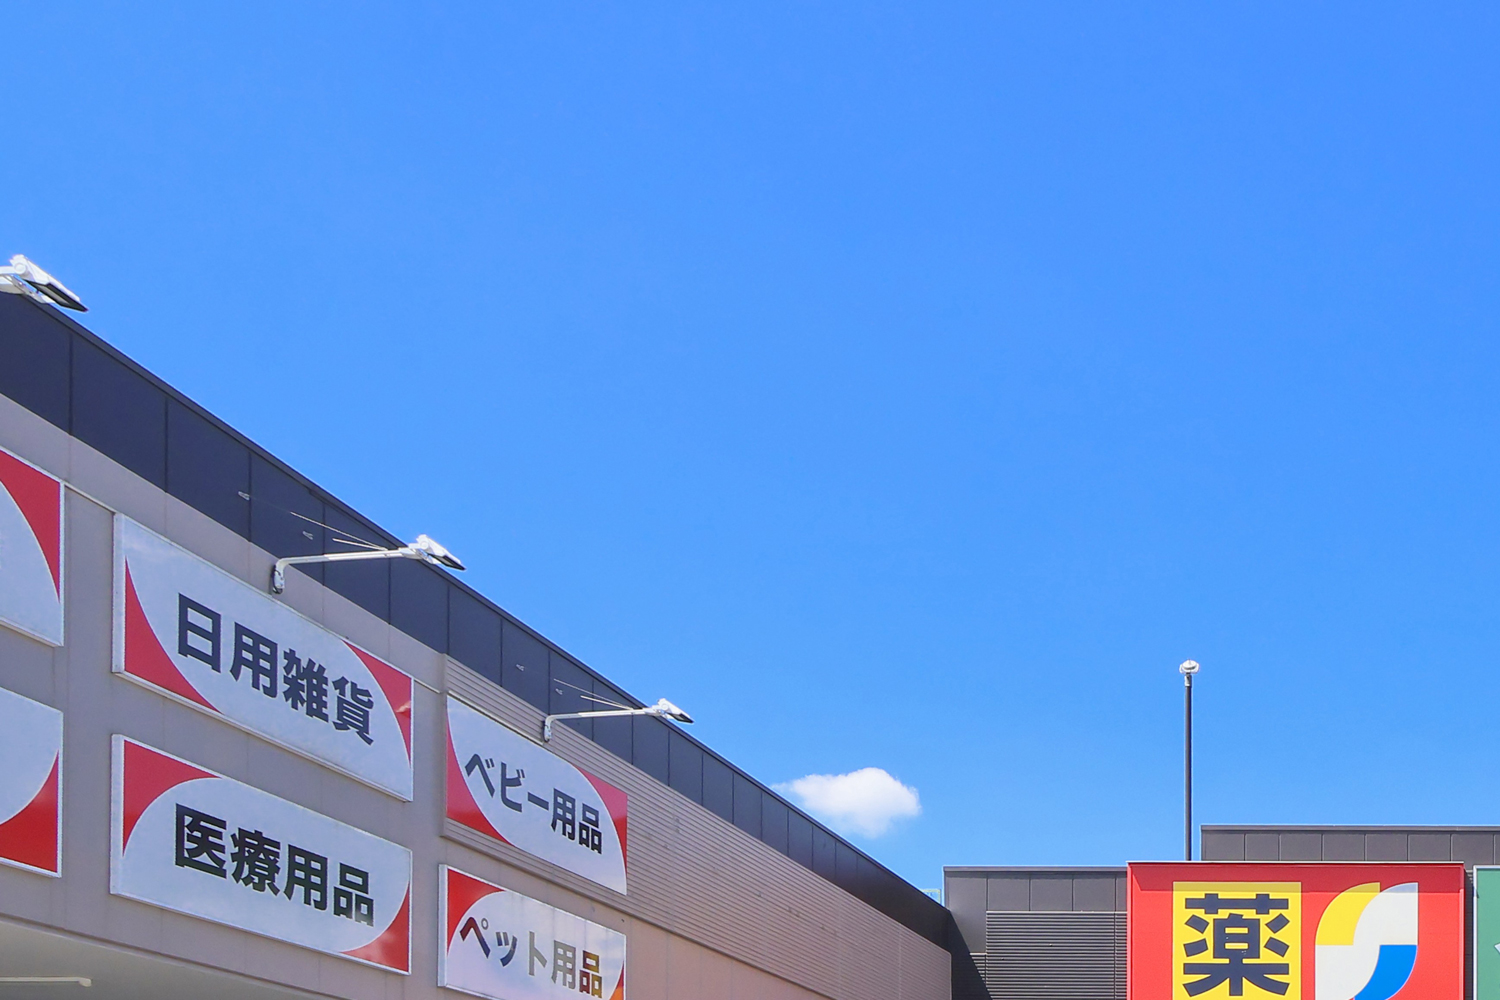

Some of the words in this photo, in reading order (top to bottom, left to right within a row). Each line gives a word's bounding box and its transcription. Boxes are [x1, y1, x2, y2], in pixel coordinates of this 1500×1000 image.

[177, 592, 375, 746] 日用雑貨
[463, 751, 603, 855] ベビー用品
[175, 803, 375, 927] 医療用品
[459, 917, 603, 1000] ペット用品
[1182, 893, 1290, 997] 薬
